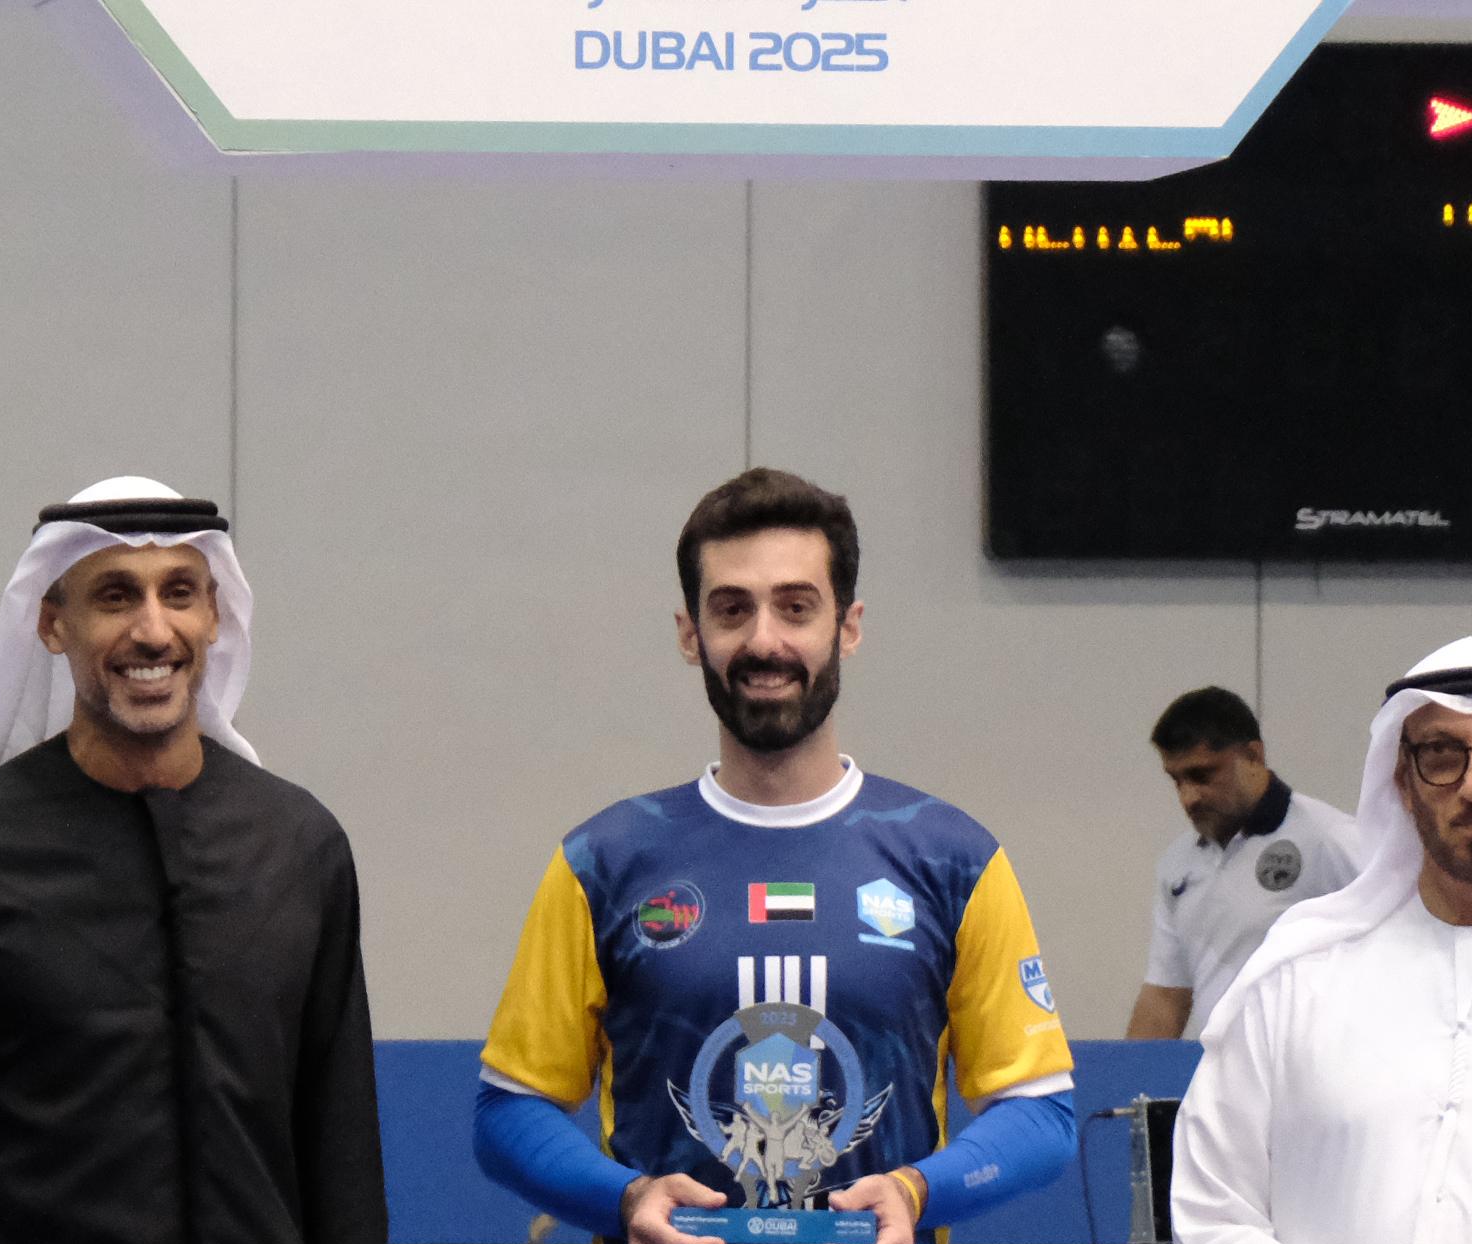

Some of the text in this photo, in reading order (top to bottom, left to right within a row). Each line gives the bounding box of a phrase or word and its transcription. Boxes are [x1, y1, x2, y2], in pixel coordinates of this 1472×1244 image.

[574, 30, 889, 72] DUBAI 2025
[1294, 507, 1450, 530] STRAMATEL
[861, 893, 912, 913] NAS
[743, 1062, 813, 1084] NAS
[743, 1083, 812, 1096] SPORTS
